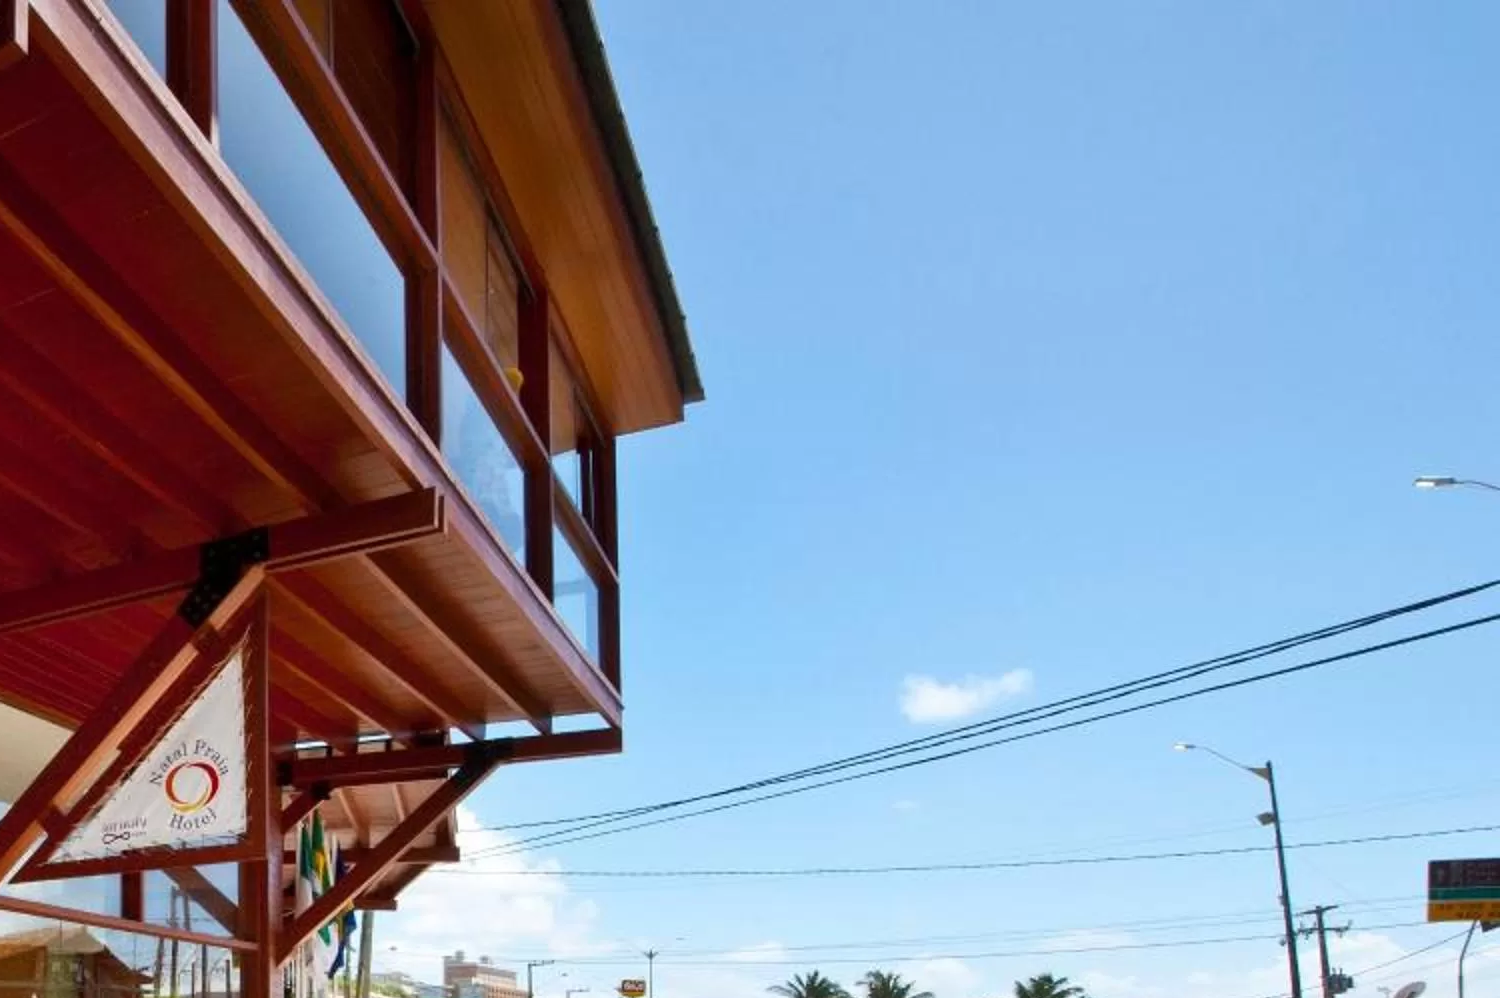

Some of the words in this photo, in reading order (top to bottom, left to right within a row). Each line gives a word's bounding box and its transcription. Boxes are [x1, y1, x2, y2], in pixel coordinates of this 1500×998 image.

[150, 742, 187, 787] Natal
[193, 739, 228, 776] Praia
[170, 808, 216, 831] Hotel
